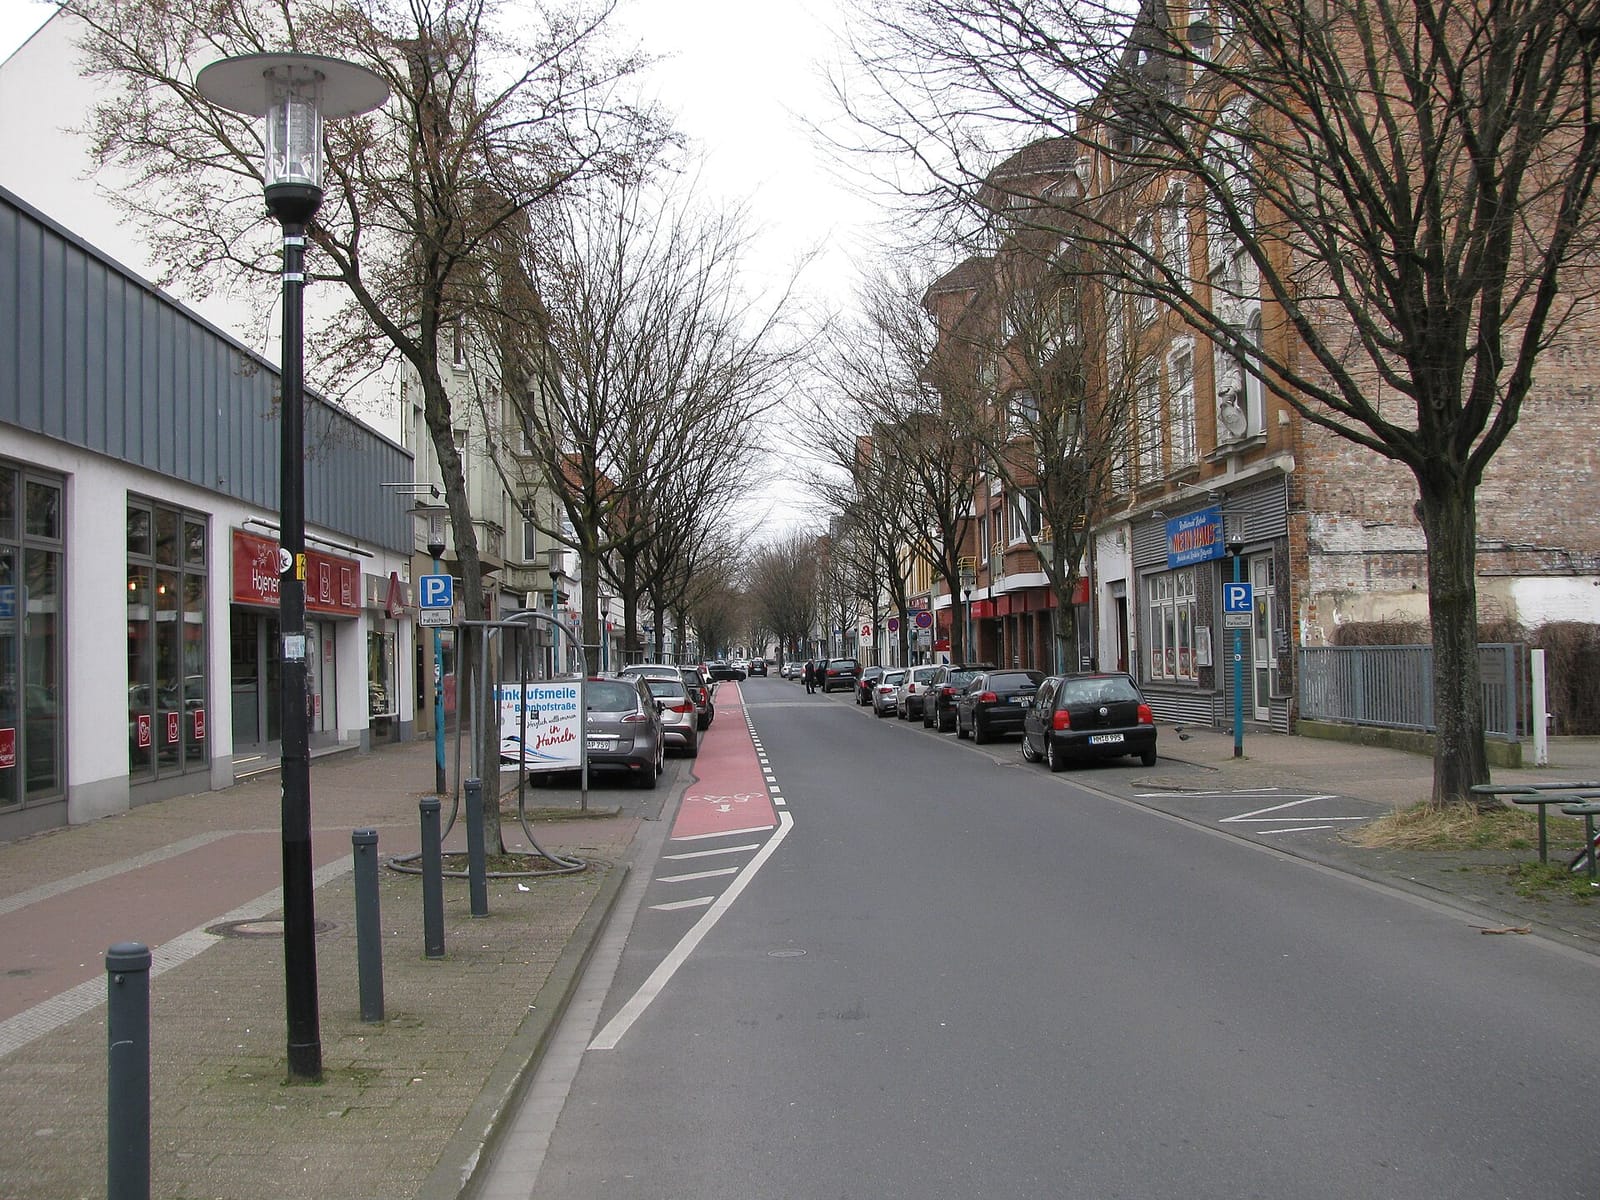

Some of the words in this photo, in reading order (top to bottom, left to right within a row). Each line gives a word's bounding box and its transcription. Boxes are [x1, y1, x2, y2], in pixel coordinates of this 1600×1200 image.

[427, 578, 445, 604] P
[1230, 586, 1246, 609] P
[515, 703, 576, 712] Bhnhofstraße
[536, 728, 576, 749] Hameln
[549, 725, 561, 734] in
